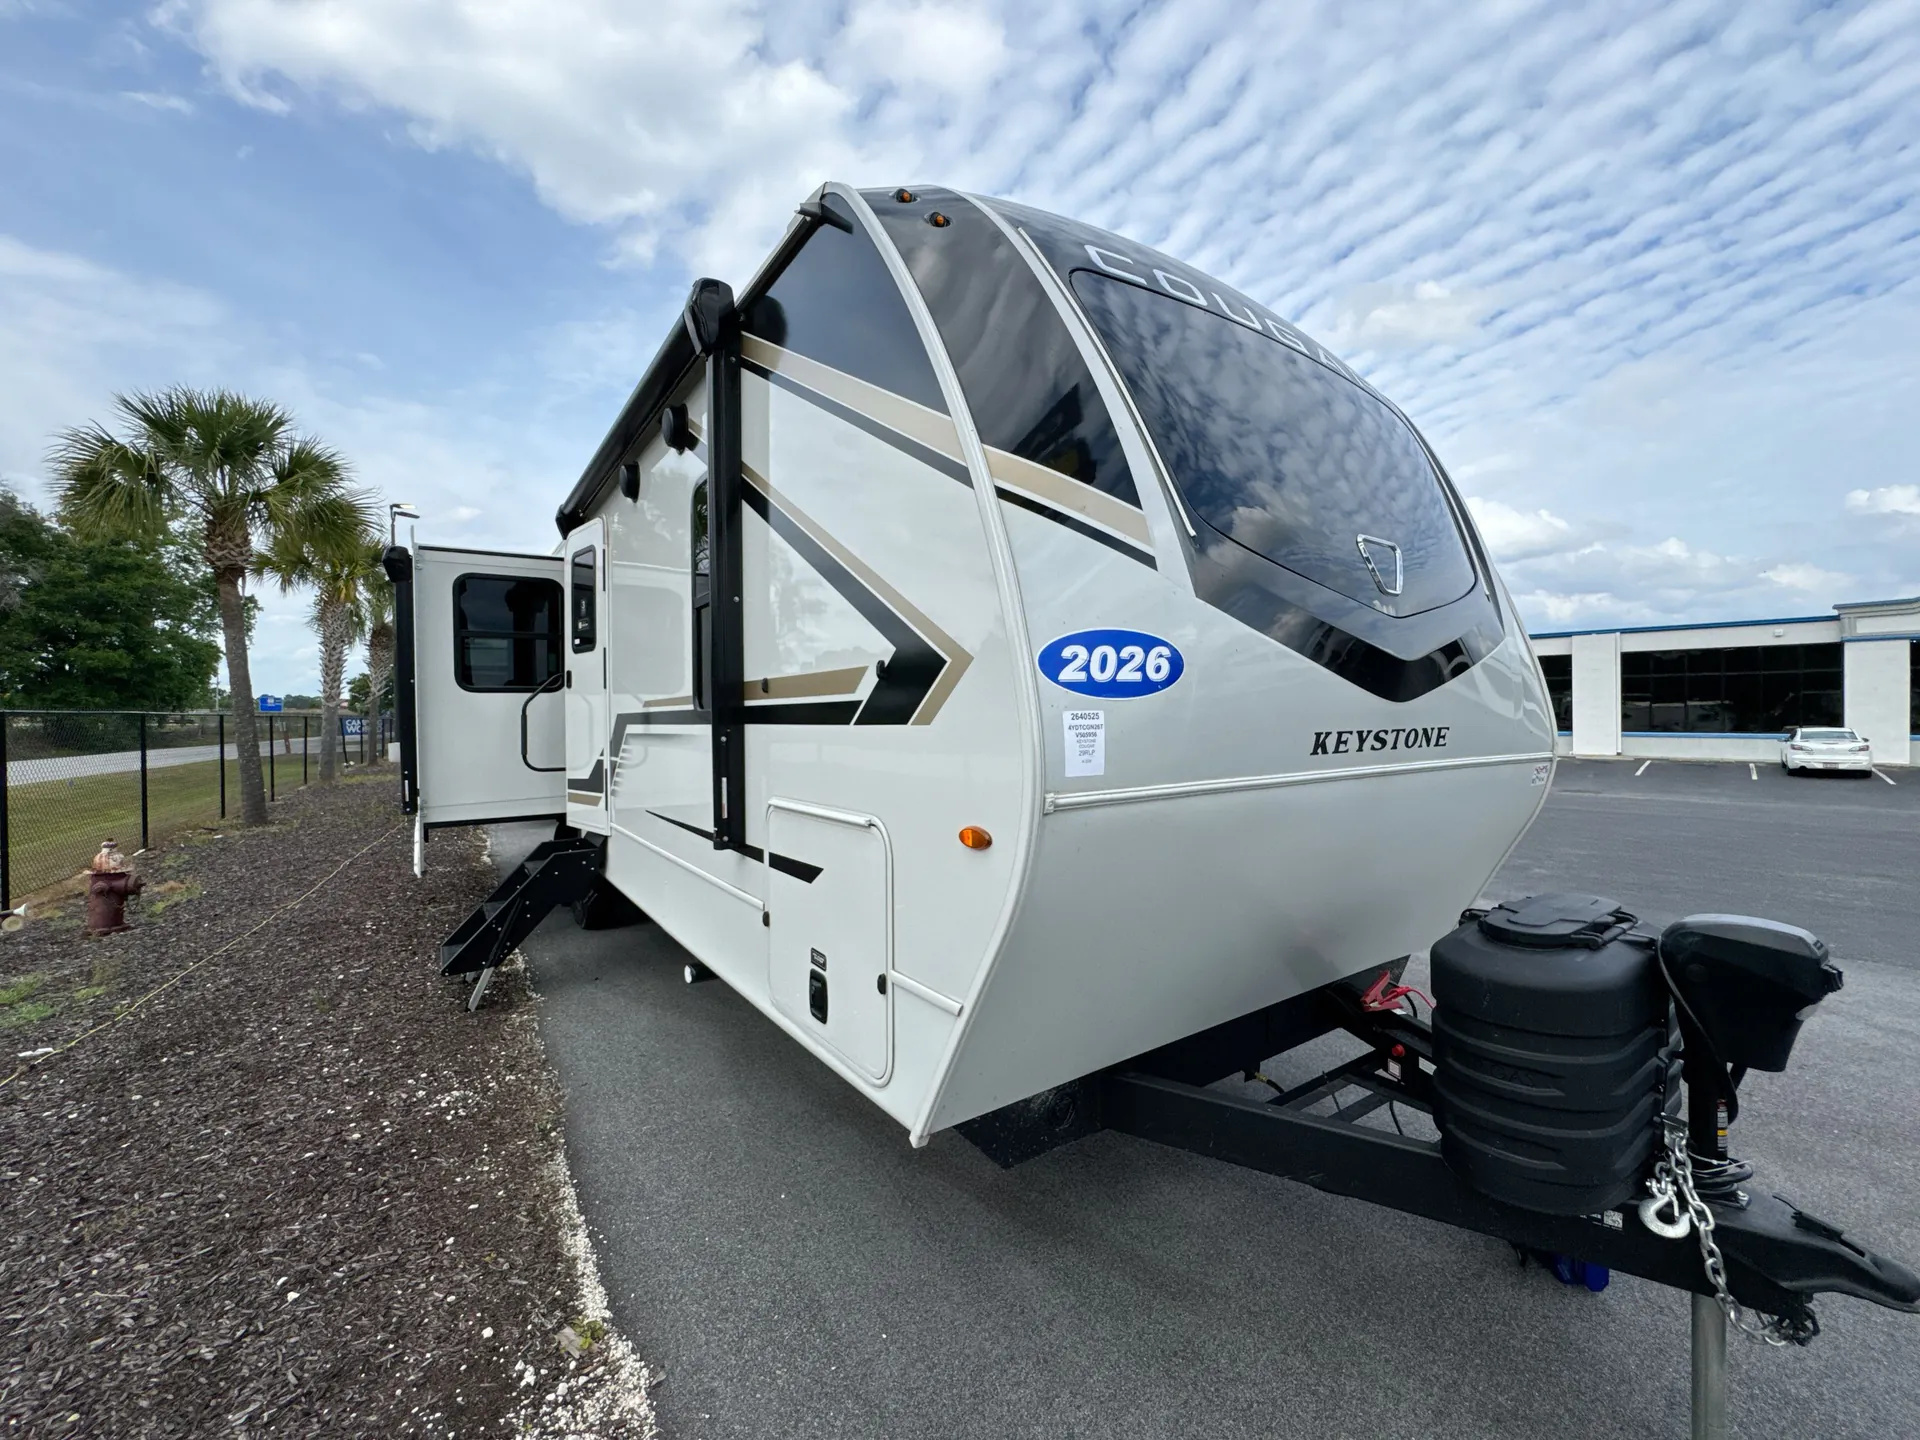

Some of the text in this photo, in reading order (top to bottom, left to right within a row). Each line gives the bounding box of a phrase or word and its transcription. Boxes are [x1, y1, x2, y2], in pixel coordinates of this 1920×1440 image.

[1058, 644, 1172, 683] 2026
[1070, 712, 1100, 721] 2640525
[1310, 726, 1450, 756] KEYSTONE
